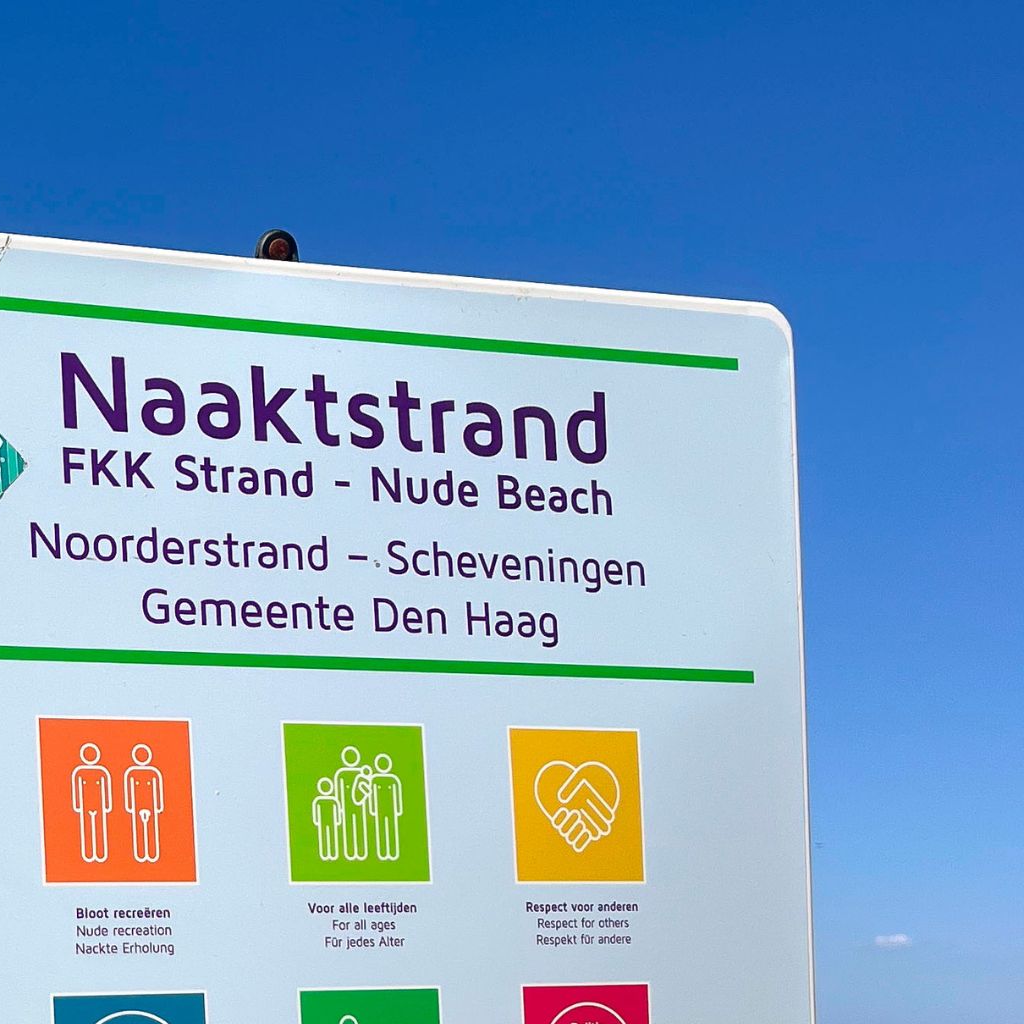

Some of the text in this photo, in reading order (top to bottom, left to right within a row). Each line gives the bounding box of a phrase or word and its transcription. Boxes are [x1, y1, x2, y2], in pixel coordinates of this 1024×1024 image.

[59, 352, 609, 465] Naaktstrand
[62, 448, 154, 490] FKK
[175, 456, 314, 498] Strand
[372, 467, 479, 508] Nude
[499, 473, 613, 516] Beach
[29, 521, 329, 572] Noorderstrand
[387, 540, 647, 593] Scheveningen
[142, 589, 559, 648] Gemeente Den Haag
[76, 907, 171, 919] Bloot recreëren
[307, 901, 417, 916] Voor alle leeftijden
[526, 901, 639, 914] Respect voor anderen
[76, 924, 172, 937] Nude recreation
[332, 919, 396, 933] For all ages
[537, 917, 630, 931] Respect for others
[324, 936, 405, 950] Für jedes Alter
[536, 934, 632, 947] Respekt für andere
[75, 942, 175, 956] Nackte Erholung
